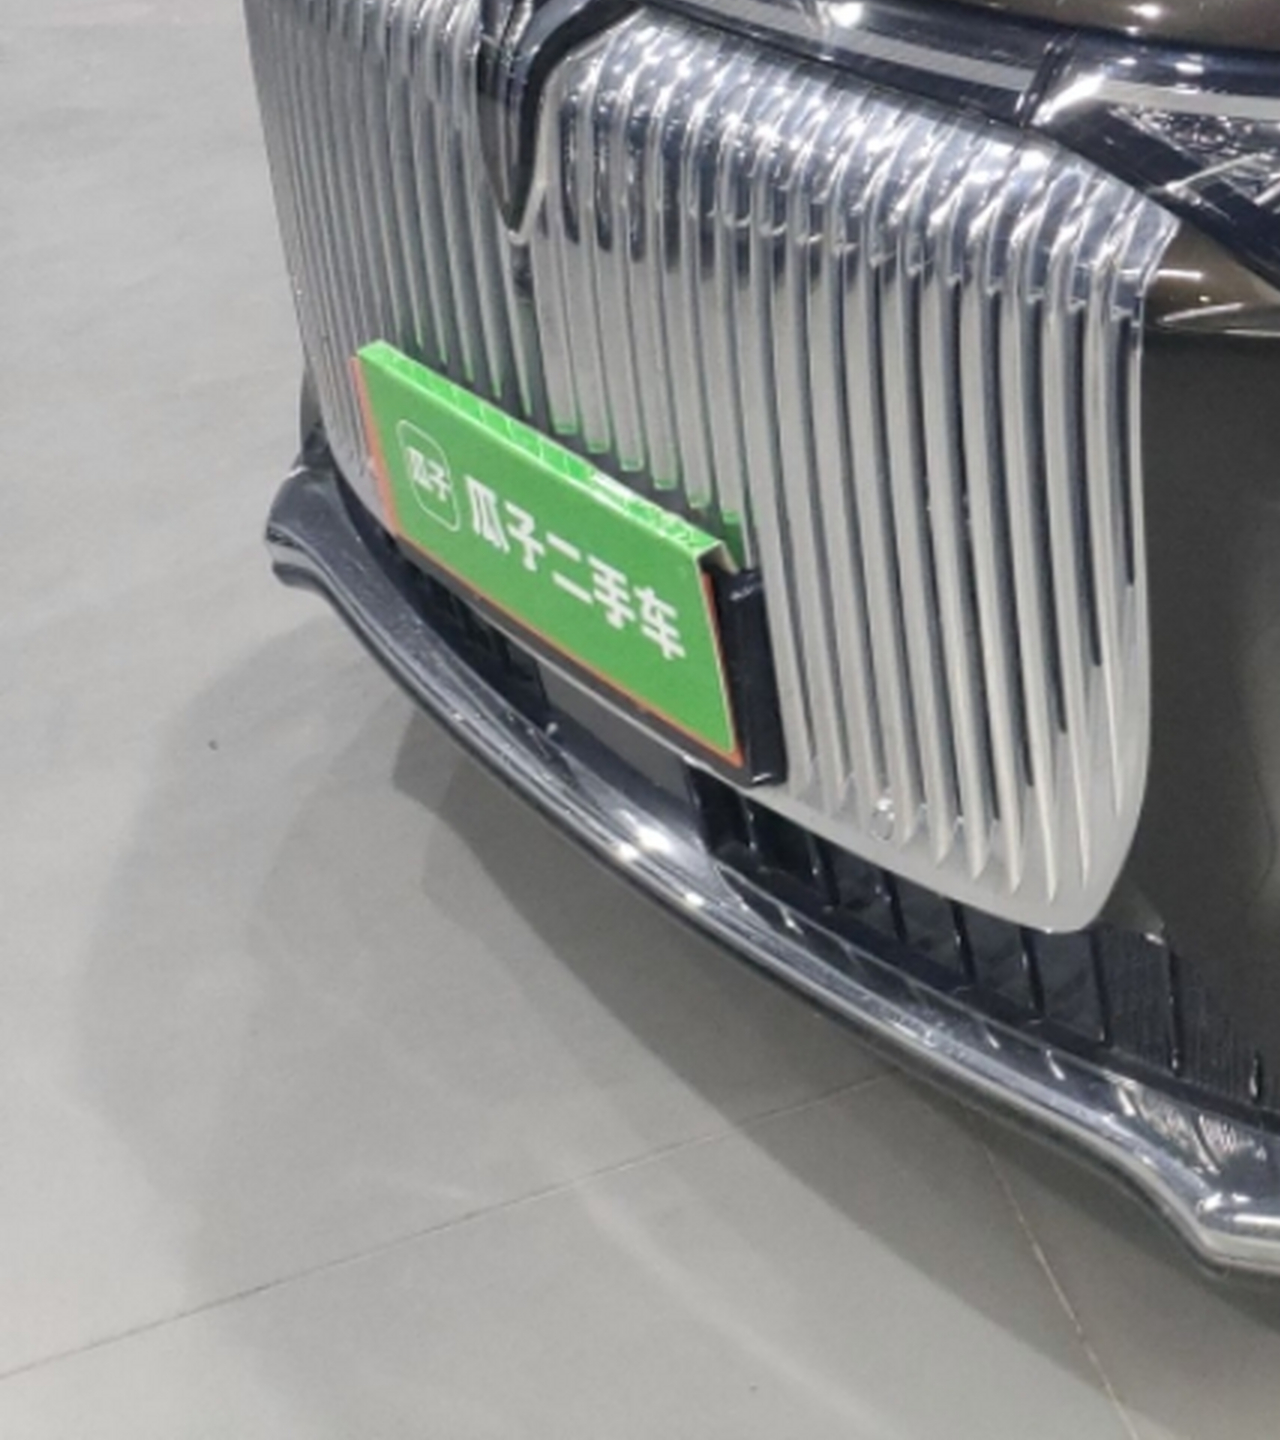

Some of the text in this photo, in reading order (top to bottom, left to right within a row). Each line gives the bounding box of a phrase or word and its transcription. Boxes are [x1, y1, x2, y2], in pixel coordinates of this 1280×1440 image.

[465, 474, 686, 661] 瓜子二手车
